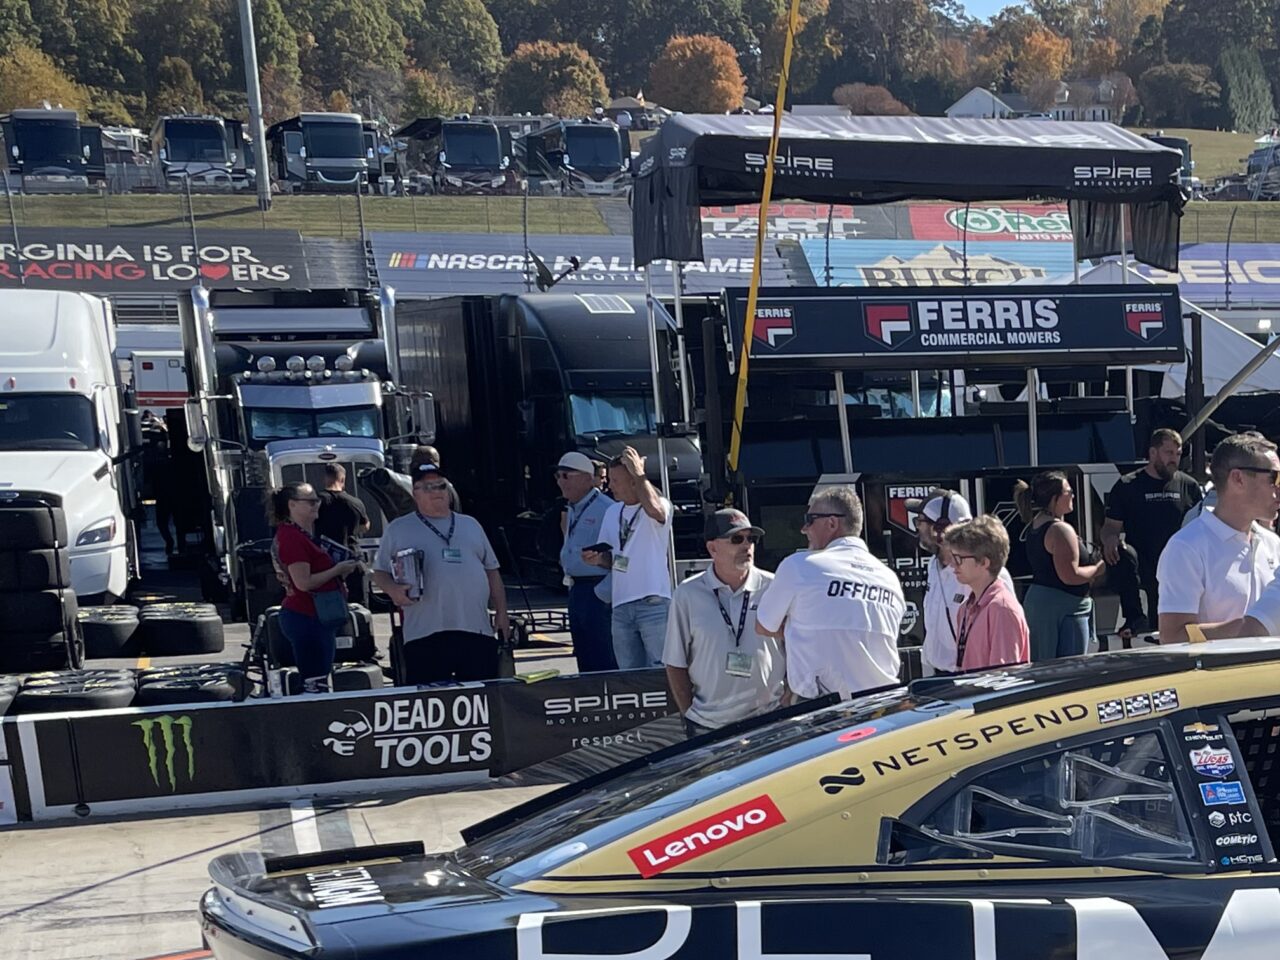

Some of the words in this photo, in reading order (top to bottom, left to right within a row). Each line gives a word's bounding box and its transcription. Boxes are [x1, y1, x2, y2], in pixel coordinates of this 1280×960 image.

[744, 146, 834, 171] SPIRE
[1073, 157, 1152, 178] SPIRE
[701, 218, 860, 232] TART
[944, 206, 1073, 233] O'Rei
[0, 243, 135, 261] RGINIA
[144, 245, 173, 262] IS
[182, 246, 260, 263] FOR
[917, 301, 1059, 330] FERRIS
[1125, 302, 1162, 313] FERRIS
[920, 331, 1005, 346] COMMERCIAL
[1006, 330, 1061, 346] MOWERS
[827, 580, 896, 608] OFFICIAL
[543, 682, 668, 716] SPIRE
[373, 697, 446, 733] DEAD
[452, 694, 490, 726] ON
[545, 710, 669, 726] MOTORSPORTS
[374, 731, 493, 769] TOOLS
[571, 731, 644, 748] respect
[871, 702, 1091, 777] NETSPEND
[1197, 753, 1229, 764] LUCAS
[1228, 810, 1253, 826] ptc
[642, 806, 768, 867] Lenovo
